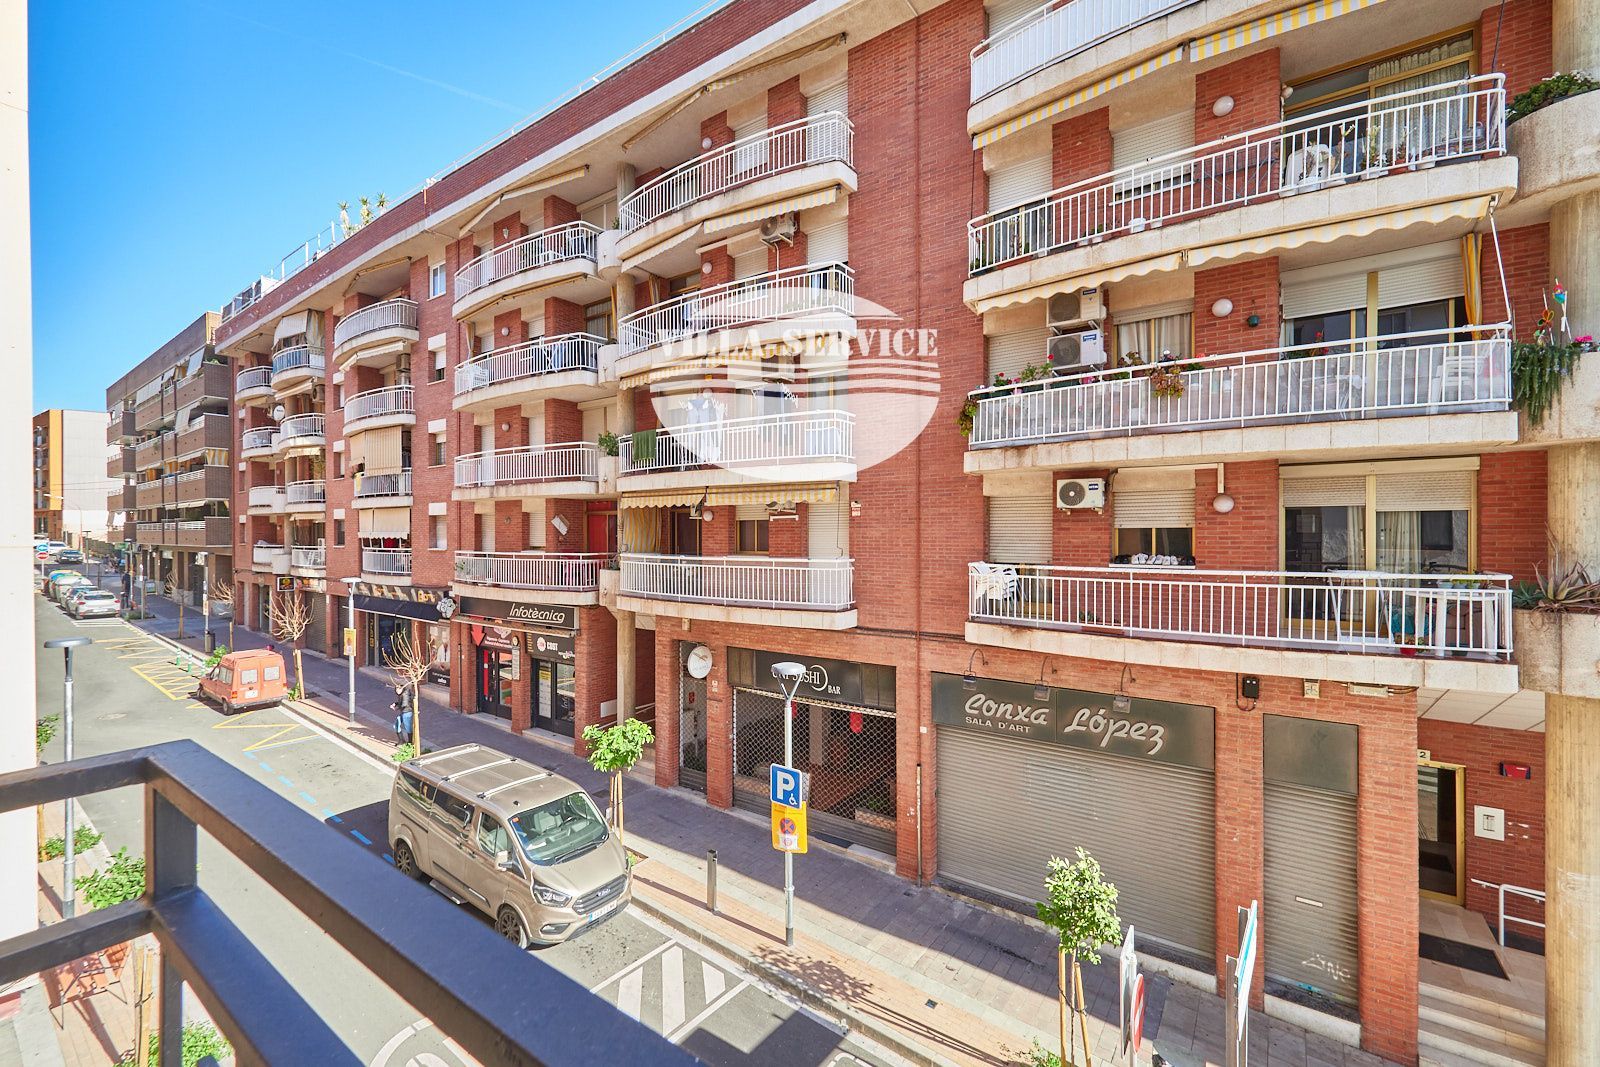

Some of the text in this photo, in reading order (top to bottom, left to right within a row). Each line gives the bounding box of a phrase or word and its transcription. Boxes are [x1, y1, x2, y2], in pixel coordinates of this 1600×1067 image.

[509, 602, 566, 621] Infotècnica
[827, 684, 841, 695] BAR
[964, 693, 1166, 756] Conxa López
[965, 716, 992, 727] SALA
[1420, 751, 1427, 759] 2
[776, 770, 795, 801] P
